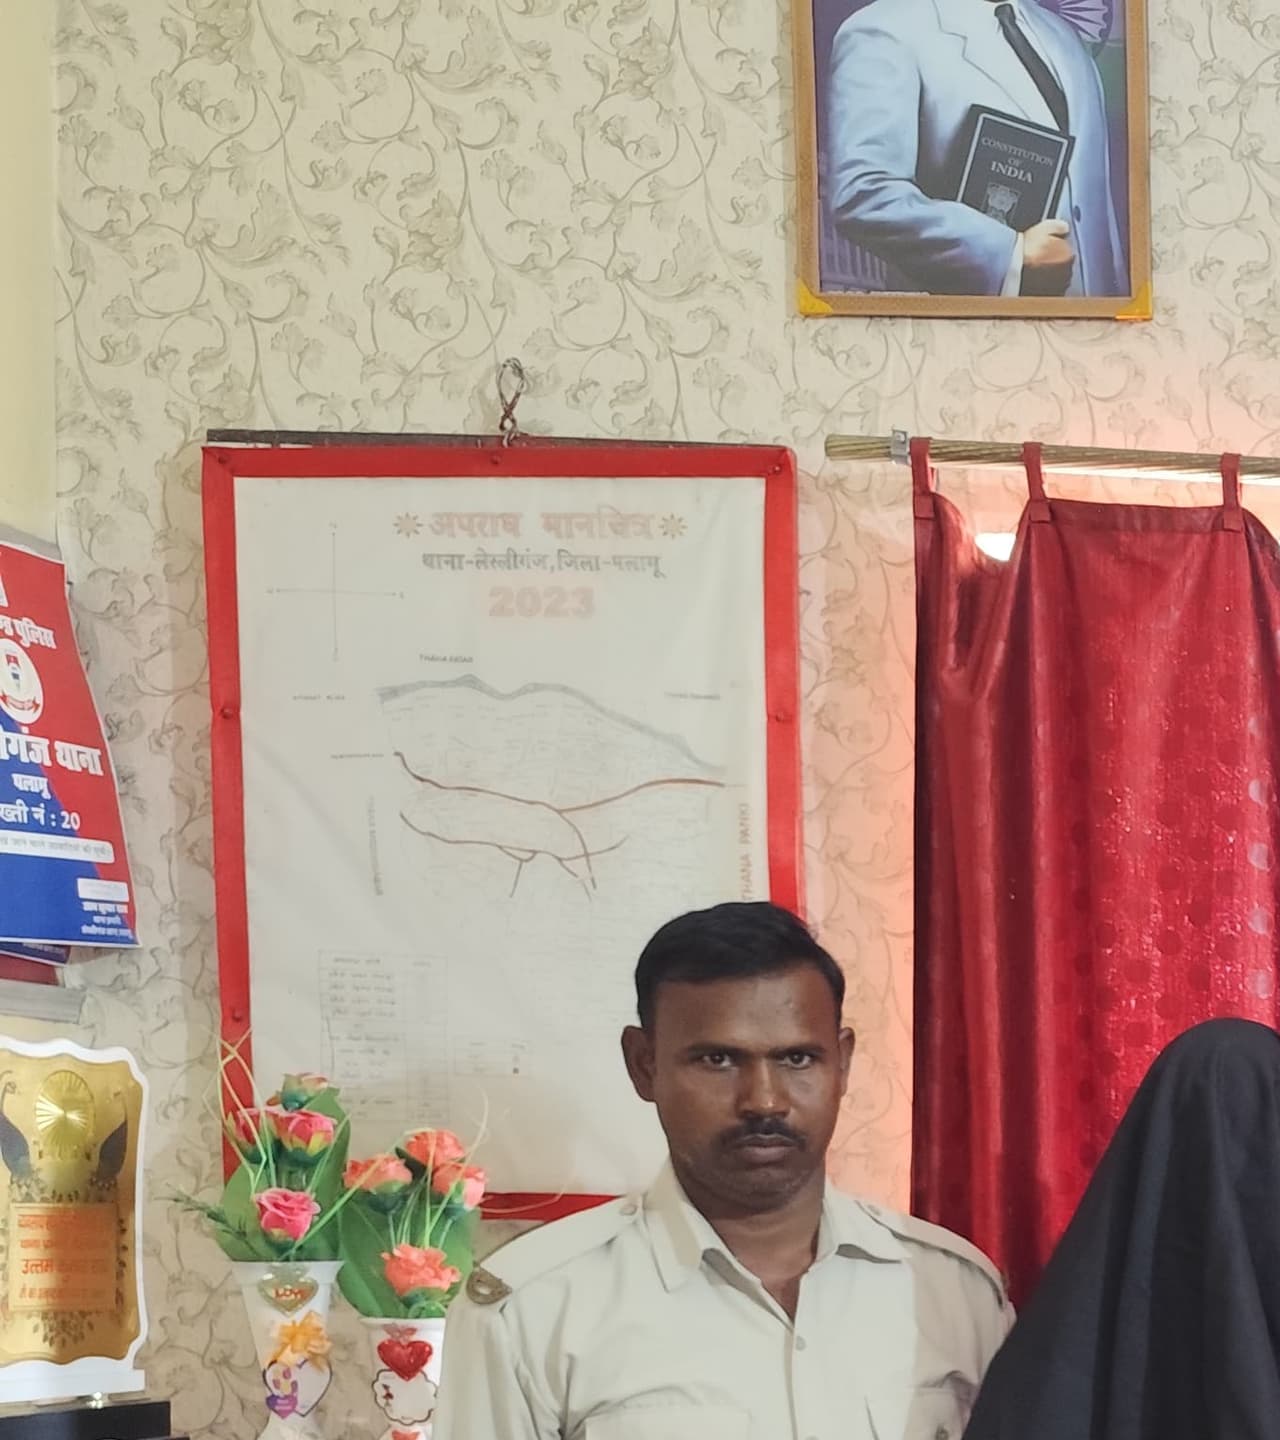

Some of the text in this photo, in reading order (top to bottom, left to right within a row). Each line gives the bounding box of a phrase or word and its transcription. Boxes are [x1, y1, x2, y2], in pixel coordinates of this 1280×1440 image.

[982, 137, 1053, 167] CONSTITUTION
[1008, 157, 1021, 167] OF
[991, 161, 1033, 183] INDIA
[429, 512, 658, 540] अपराध मानचित्र
[488, 586, 595, 619] 2023
[13, 616, 57, 650] पुलिस
[54, 740, 104, 776] थाना
[12, 773, 52, 800] पलामू
[61, 811, 81, 831] 20
